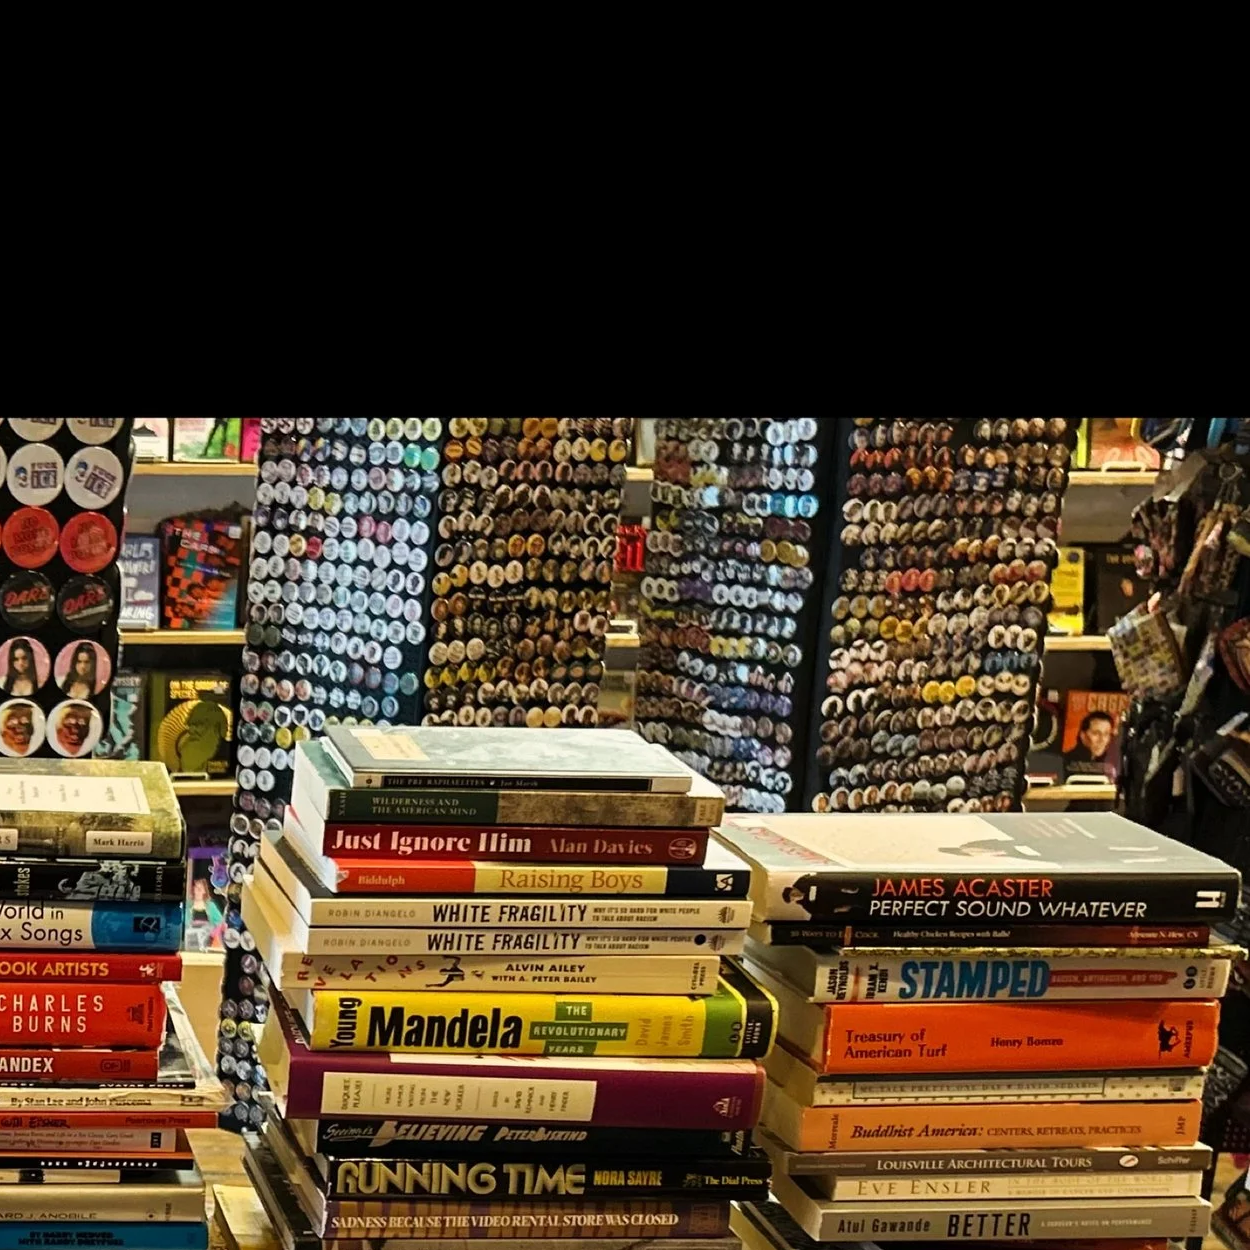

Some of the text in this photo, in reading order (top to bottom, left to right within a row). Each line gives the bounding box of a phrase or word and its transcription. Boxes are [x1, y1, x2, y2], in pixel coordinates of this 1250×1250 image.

[500, 870, 643, 893] Raising Boys
[872, 879, 1053, 897] JAMES ACASTER
[433, 904, 587, 923] WHITE FRAGILITY
[869, 901, 1147, 918] PERFECT SOUND WHATEVER
[43, 962, 109, 976] ARTISTS
[506, 962, 585, 973] ALVIN AILEY
[899, 960, 1050, 999] STAMPED
[13, 1016, 87, 1033] BURNS
[368, 1006, 522, 1048] Mandela
[877, 1157, 1092, 1171] LOUISVILLE ARCHITECTURAL TOURS
[948, 1213, 1031, 1237] BETTER
